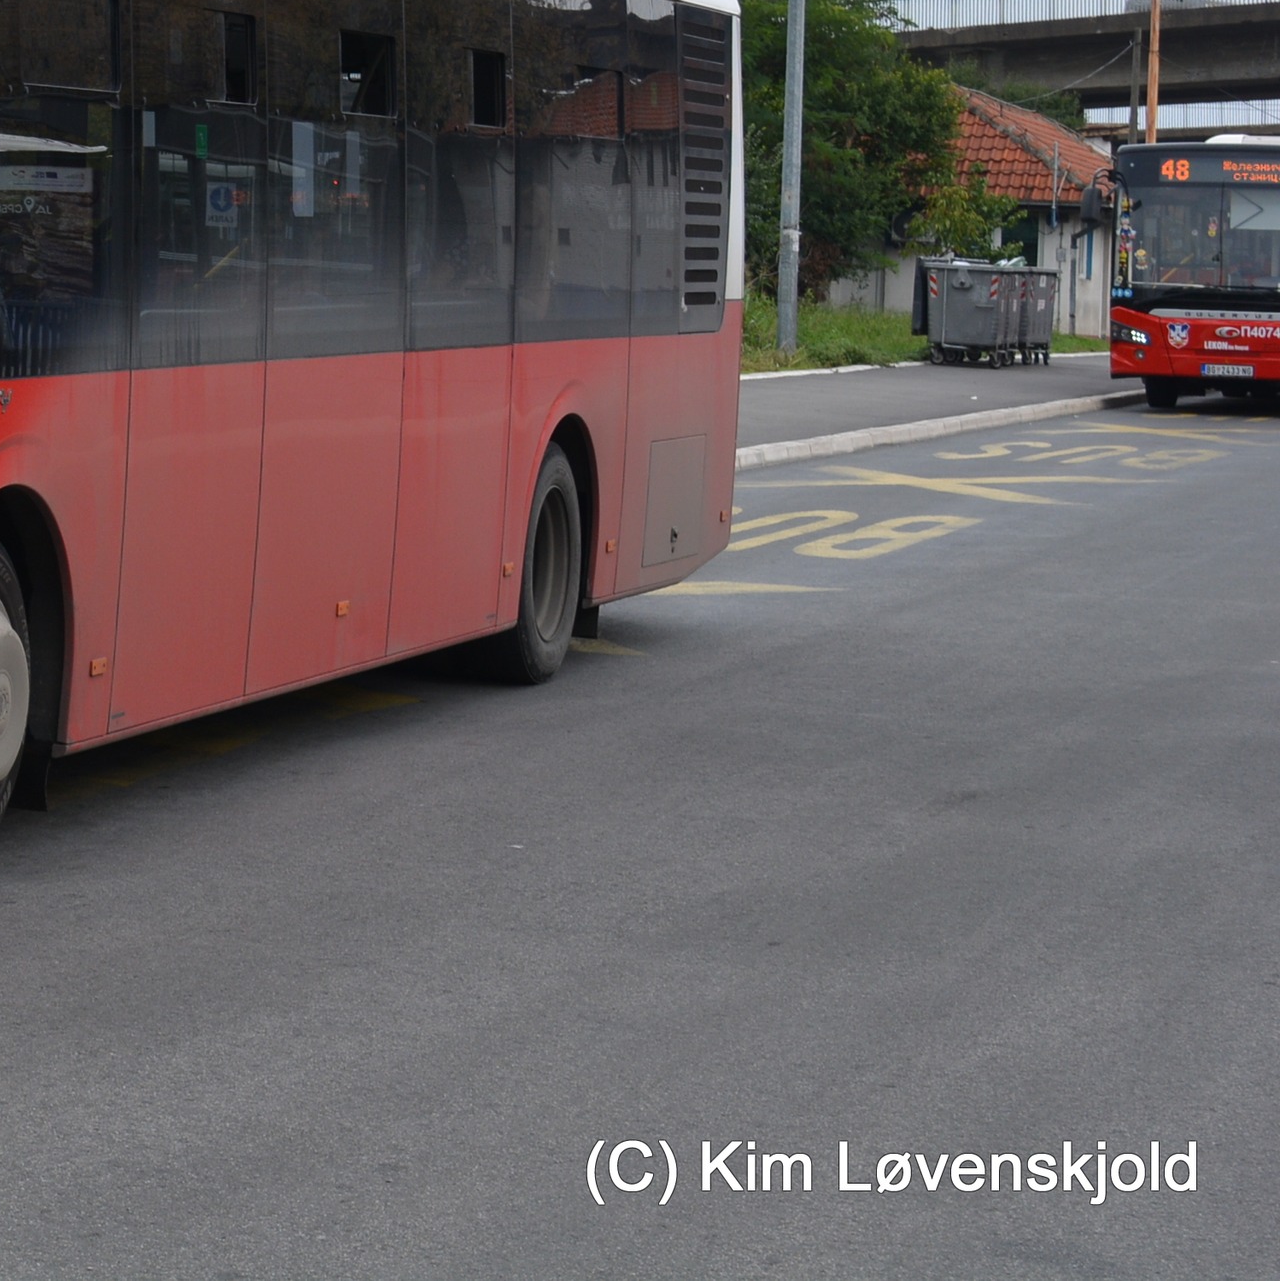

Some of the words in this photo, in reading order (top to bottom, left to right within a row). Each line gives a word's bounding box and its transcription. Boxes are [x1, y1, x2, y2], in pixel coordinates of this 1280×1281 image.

[1161, 159, 1190, 181] 48
[1233, 172, 1280, 183] станиц
[933, 441, 1235, 471] BUS
[730, 507, 984, 560] BU
